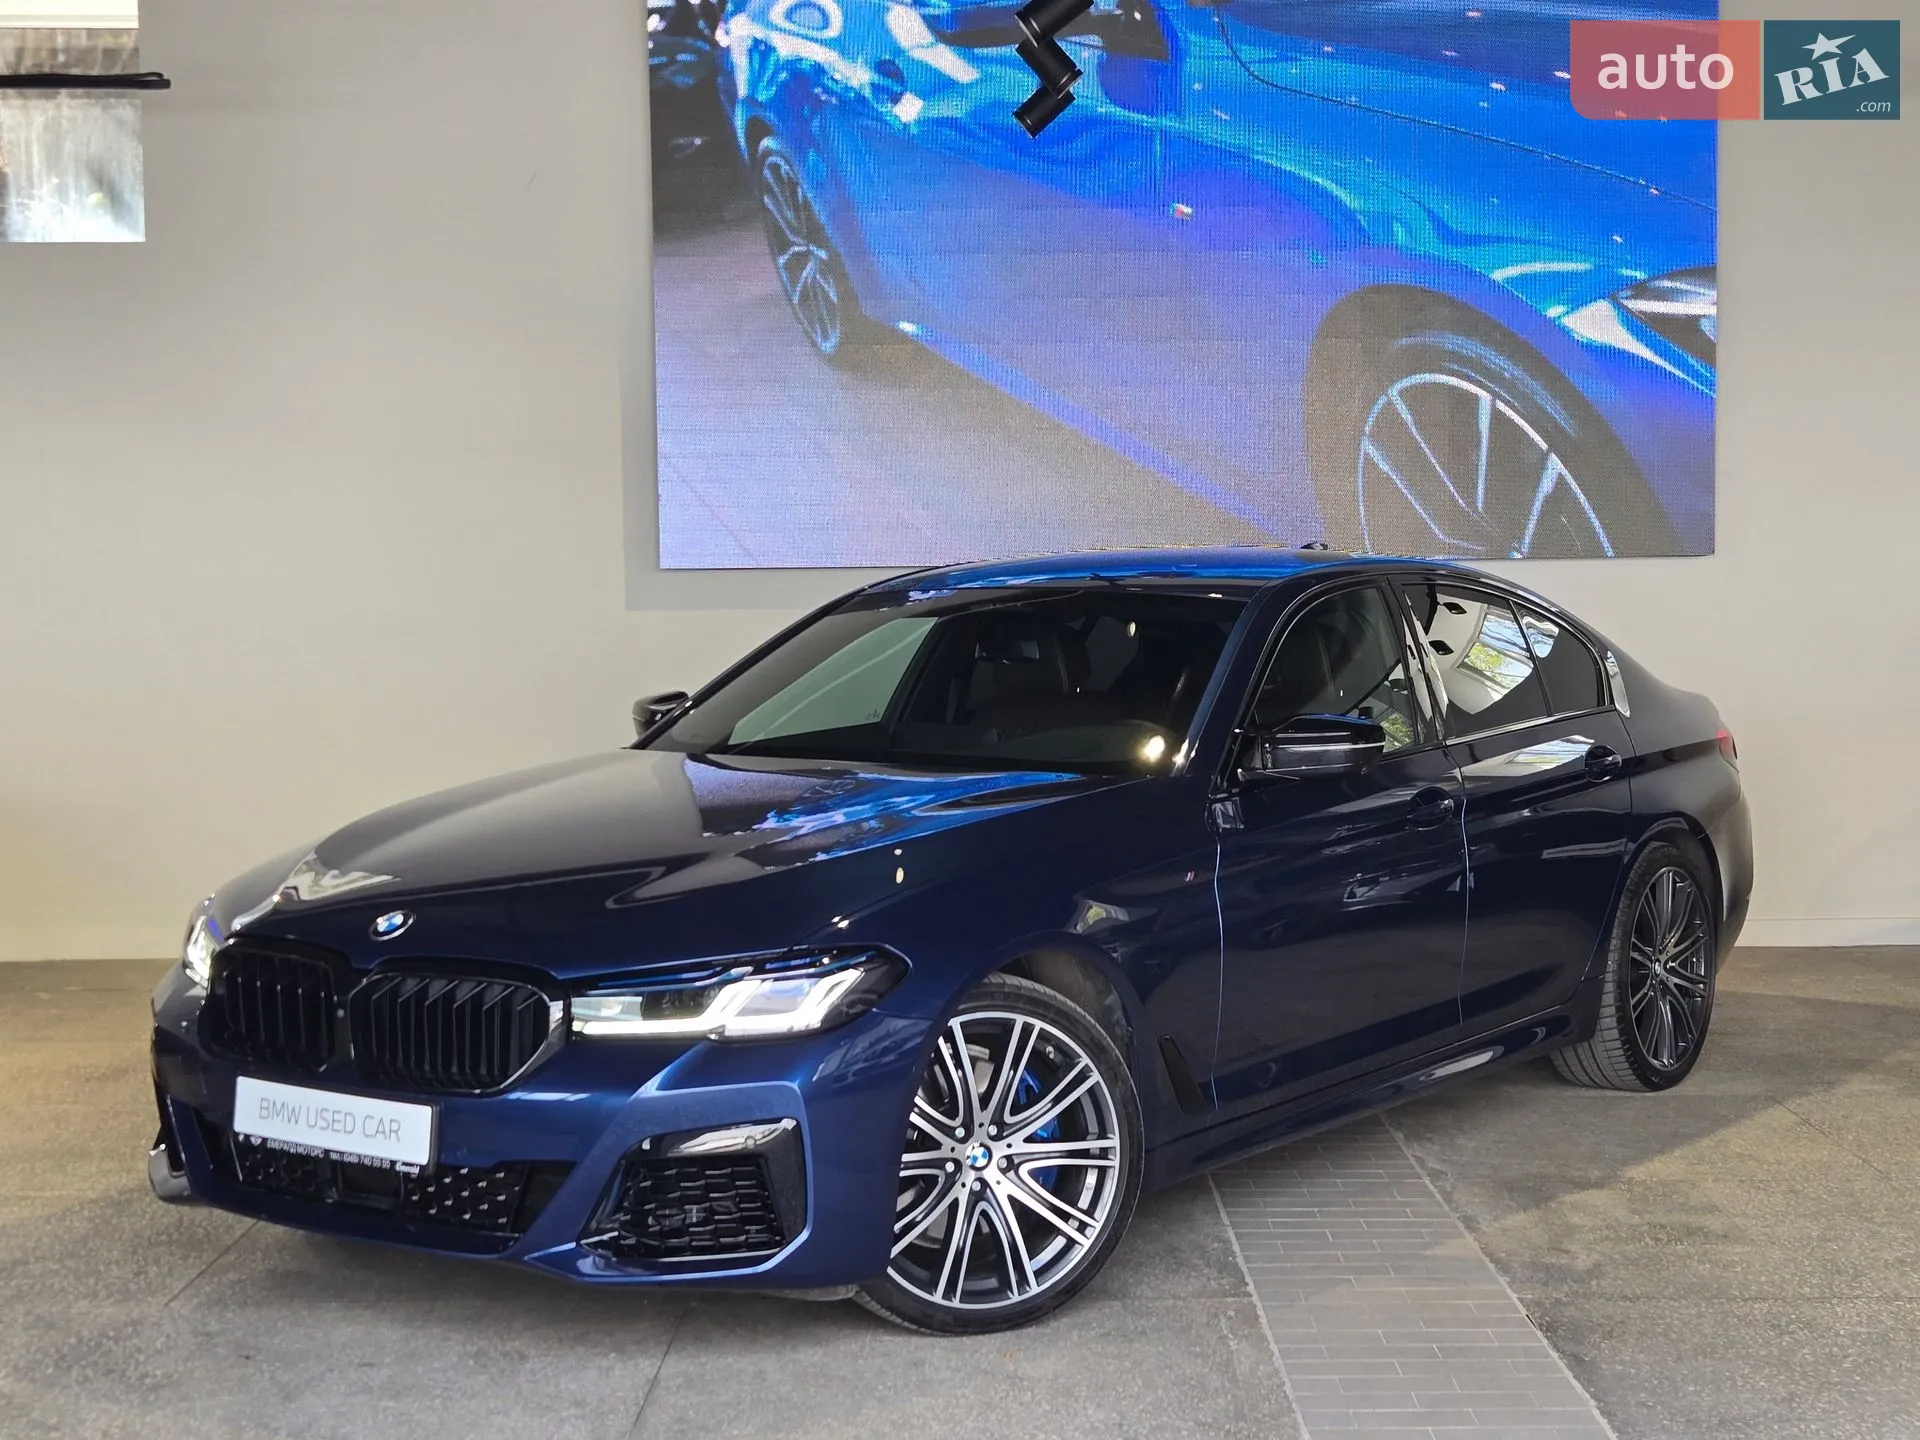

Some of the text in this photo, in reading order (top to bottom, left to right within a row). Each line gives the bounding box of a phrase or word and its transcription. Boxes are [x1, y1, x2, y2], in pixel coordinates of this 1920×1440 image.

[258, 1097, 402, 1143] BMW USED CAR
